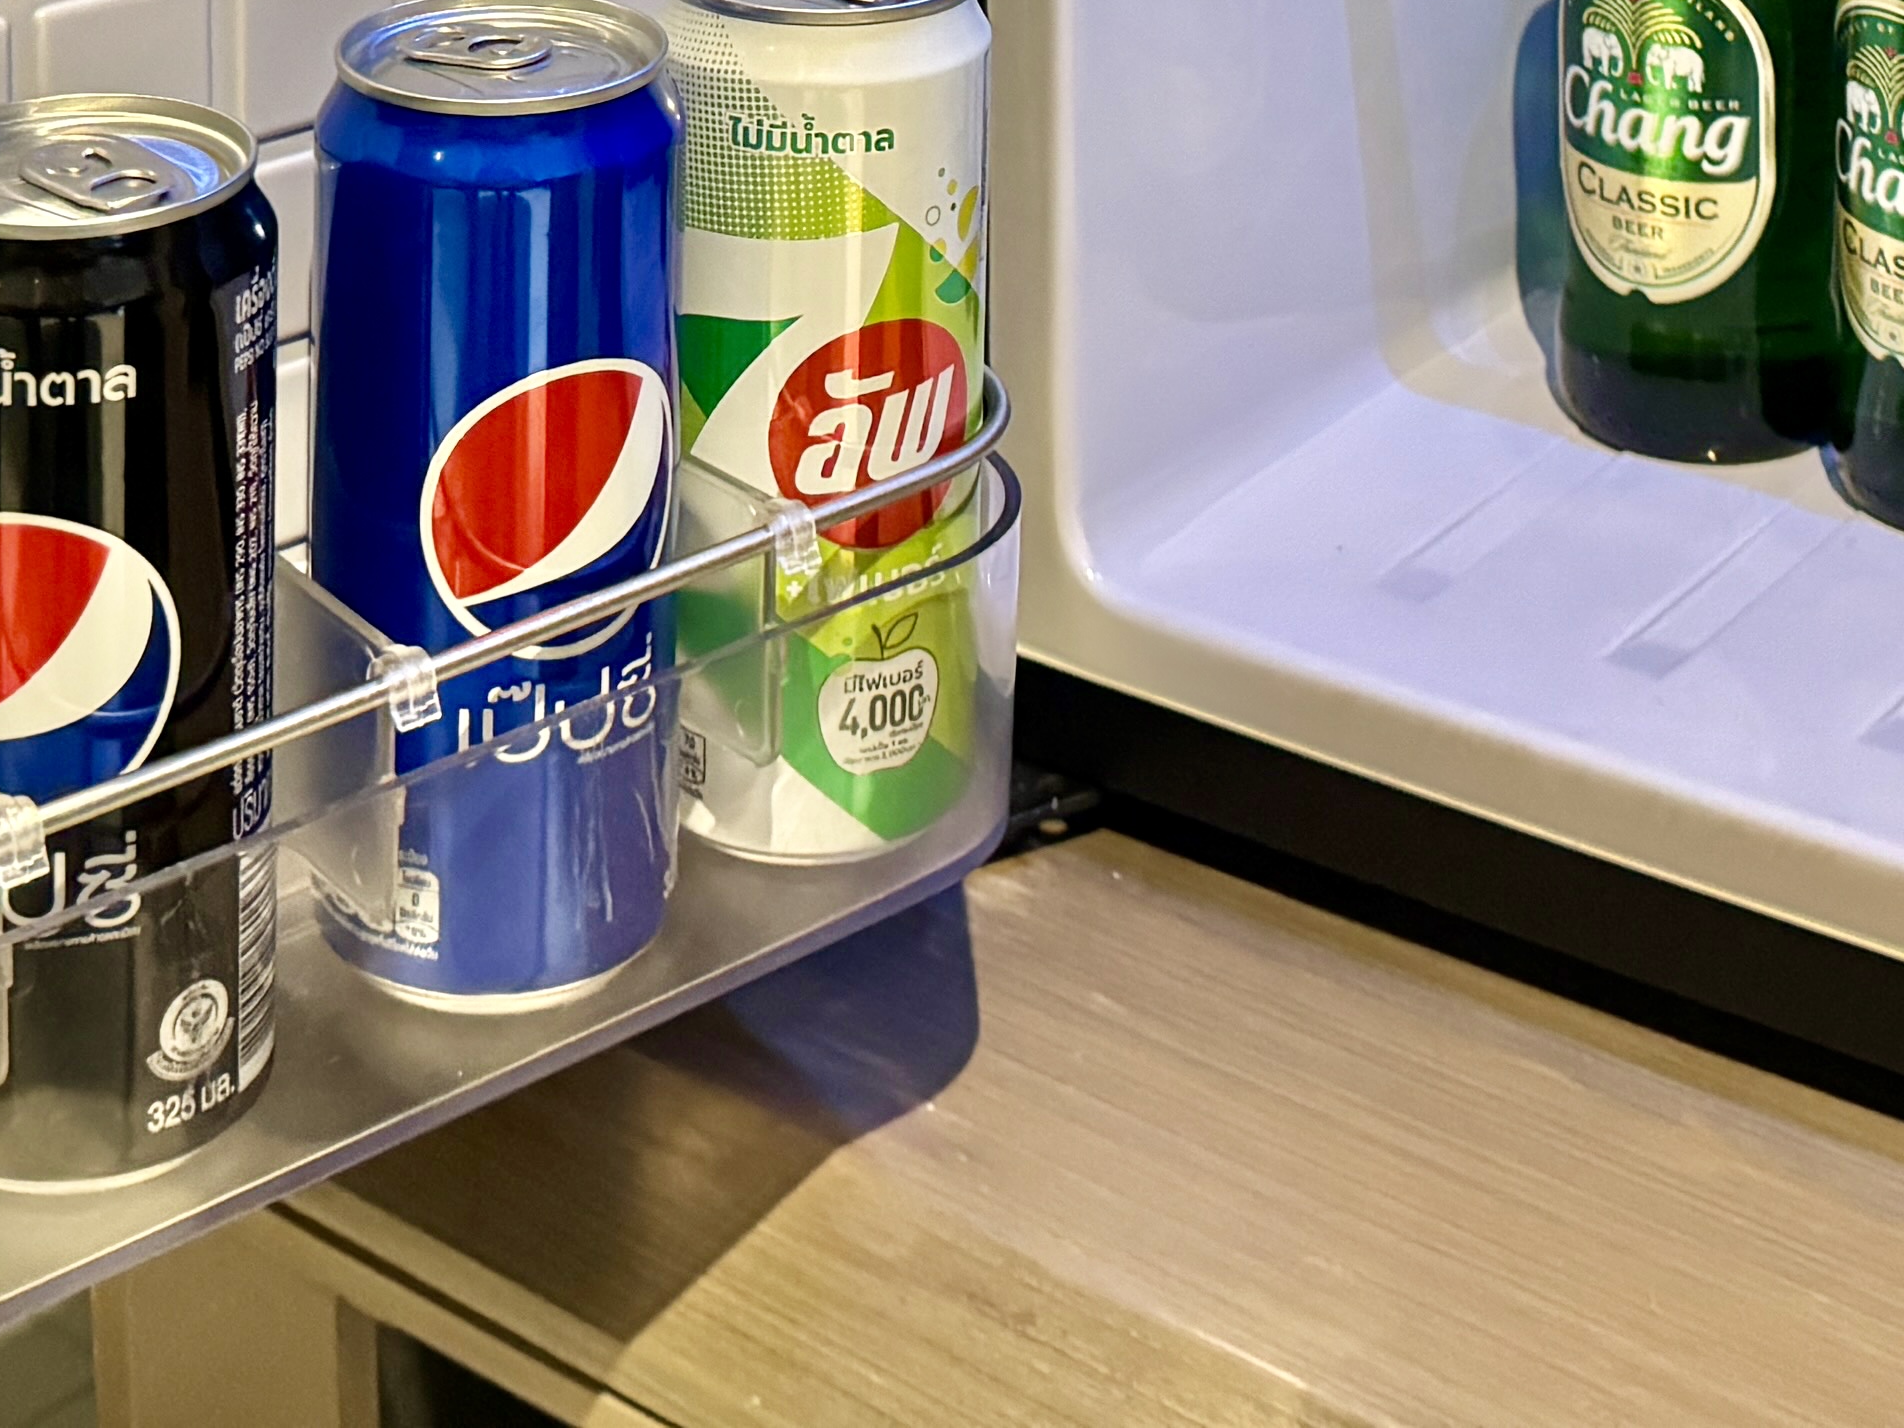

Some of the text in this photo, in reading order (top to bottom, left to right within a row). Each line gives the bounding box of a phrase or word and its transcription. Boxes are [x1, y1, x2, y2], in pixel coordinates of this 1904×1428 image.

[1565, 64, 1751, 177] Chang
[1687, 98, 1742, 113] BEER
[727, 112, 896, 156] ไม่มีน้ำตาล
[1577, 161, 1718, 221] CLASSIC
[1612, 216, 1664, 241] BEER
[793, 358, 956, 498] อัพ
[843, 658, 925, 694] มีไฟเบอร์
[838, 682, 925, 740] 4,000
